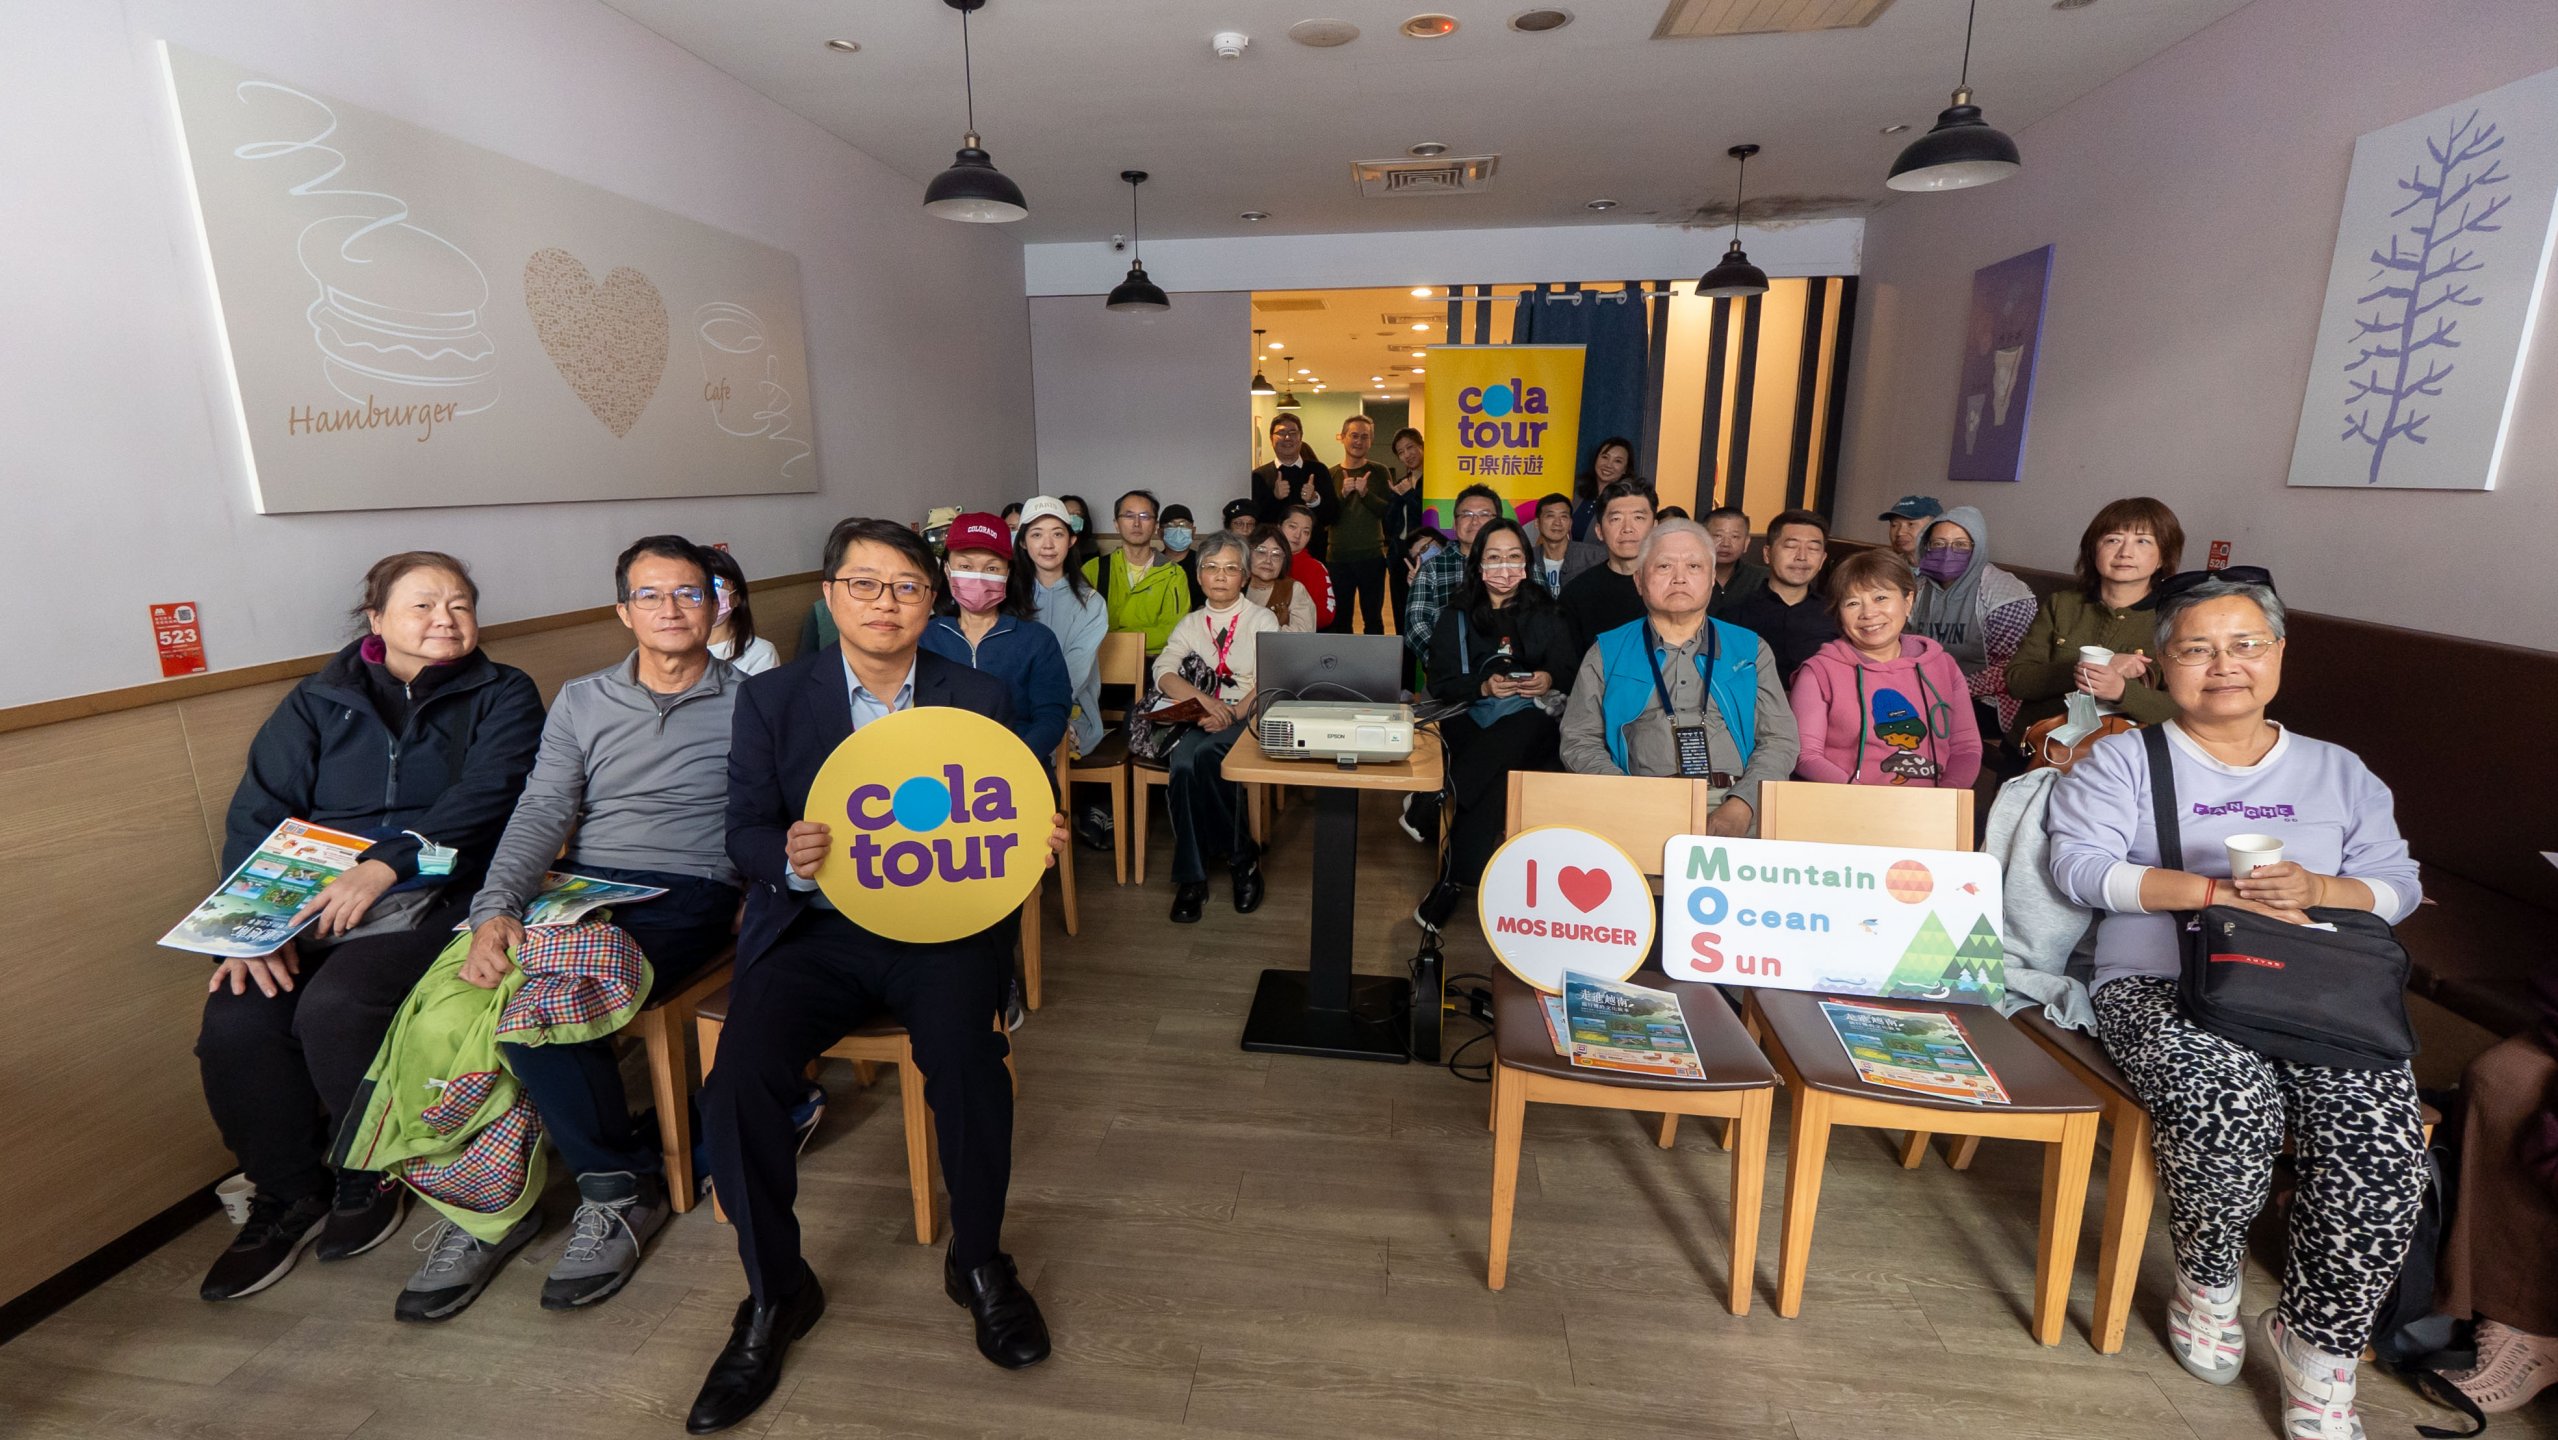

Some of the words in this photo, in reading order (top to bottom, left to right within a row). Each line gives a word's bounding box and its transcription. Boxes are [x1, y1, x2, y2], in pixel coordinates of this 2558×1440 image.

[289, 394, 458, 443] Hamburger
[1458, 378, 1549, 417] cola
[1458, 415, 1548, 448] tour
[967, 525, 998, 540] COLORADO
[159, 628, 198, 646] 523
[846, 764, 1017, 832] cola
[850, 833, 1018, 889] tour
[1526, 859, 1537, 908] I
[1686, 845, 1876, 890] Mountain
[1496, 916, 1547, 937] MOS
[1551, 921, 1637, 946] BURGER
[1687, 886, 1830, 933] Ocean
[1690, 931, 1781, 977] Sun
